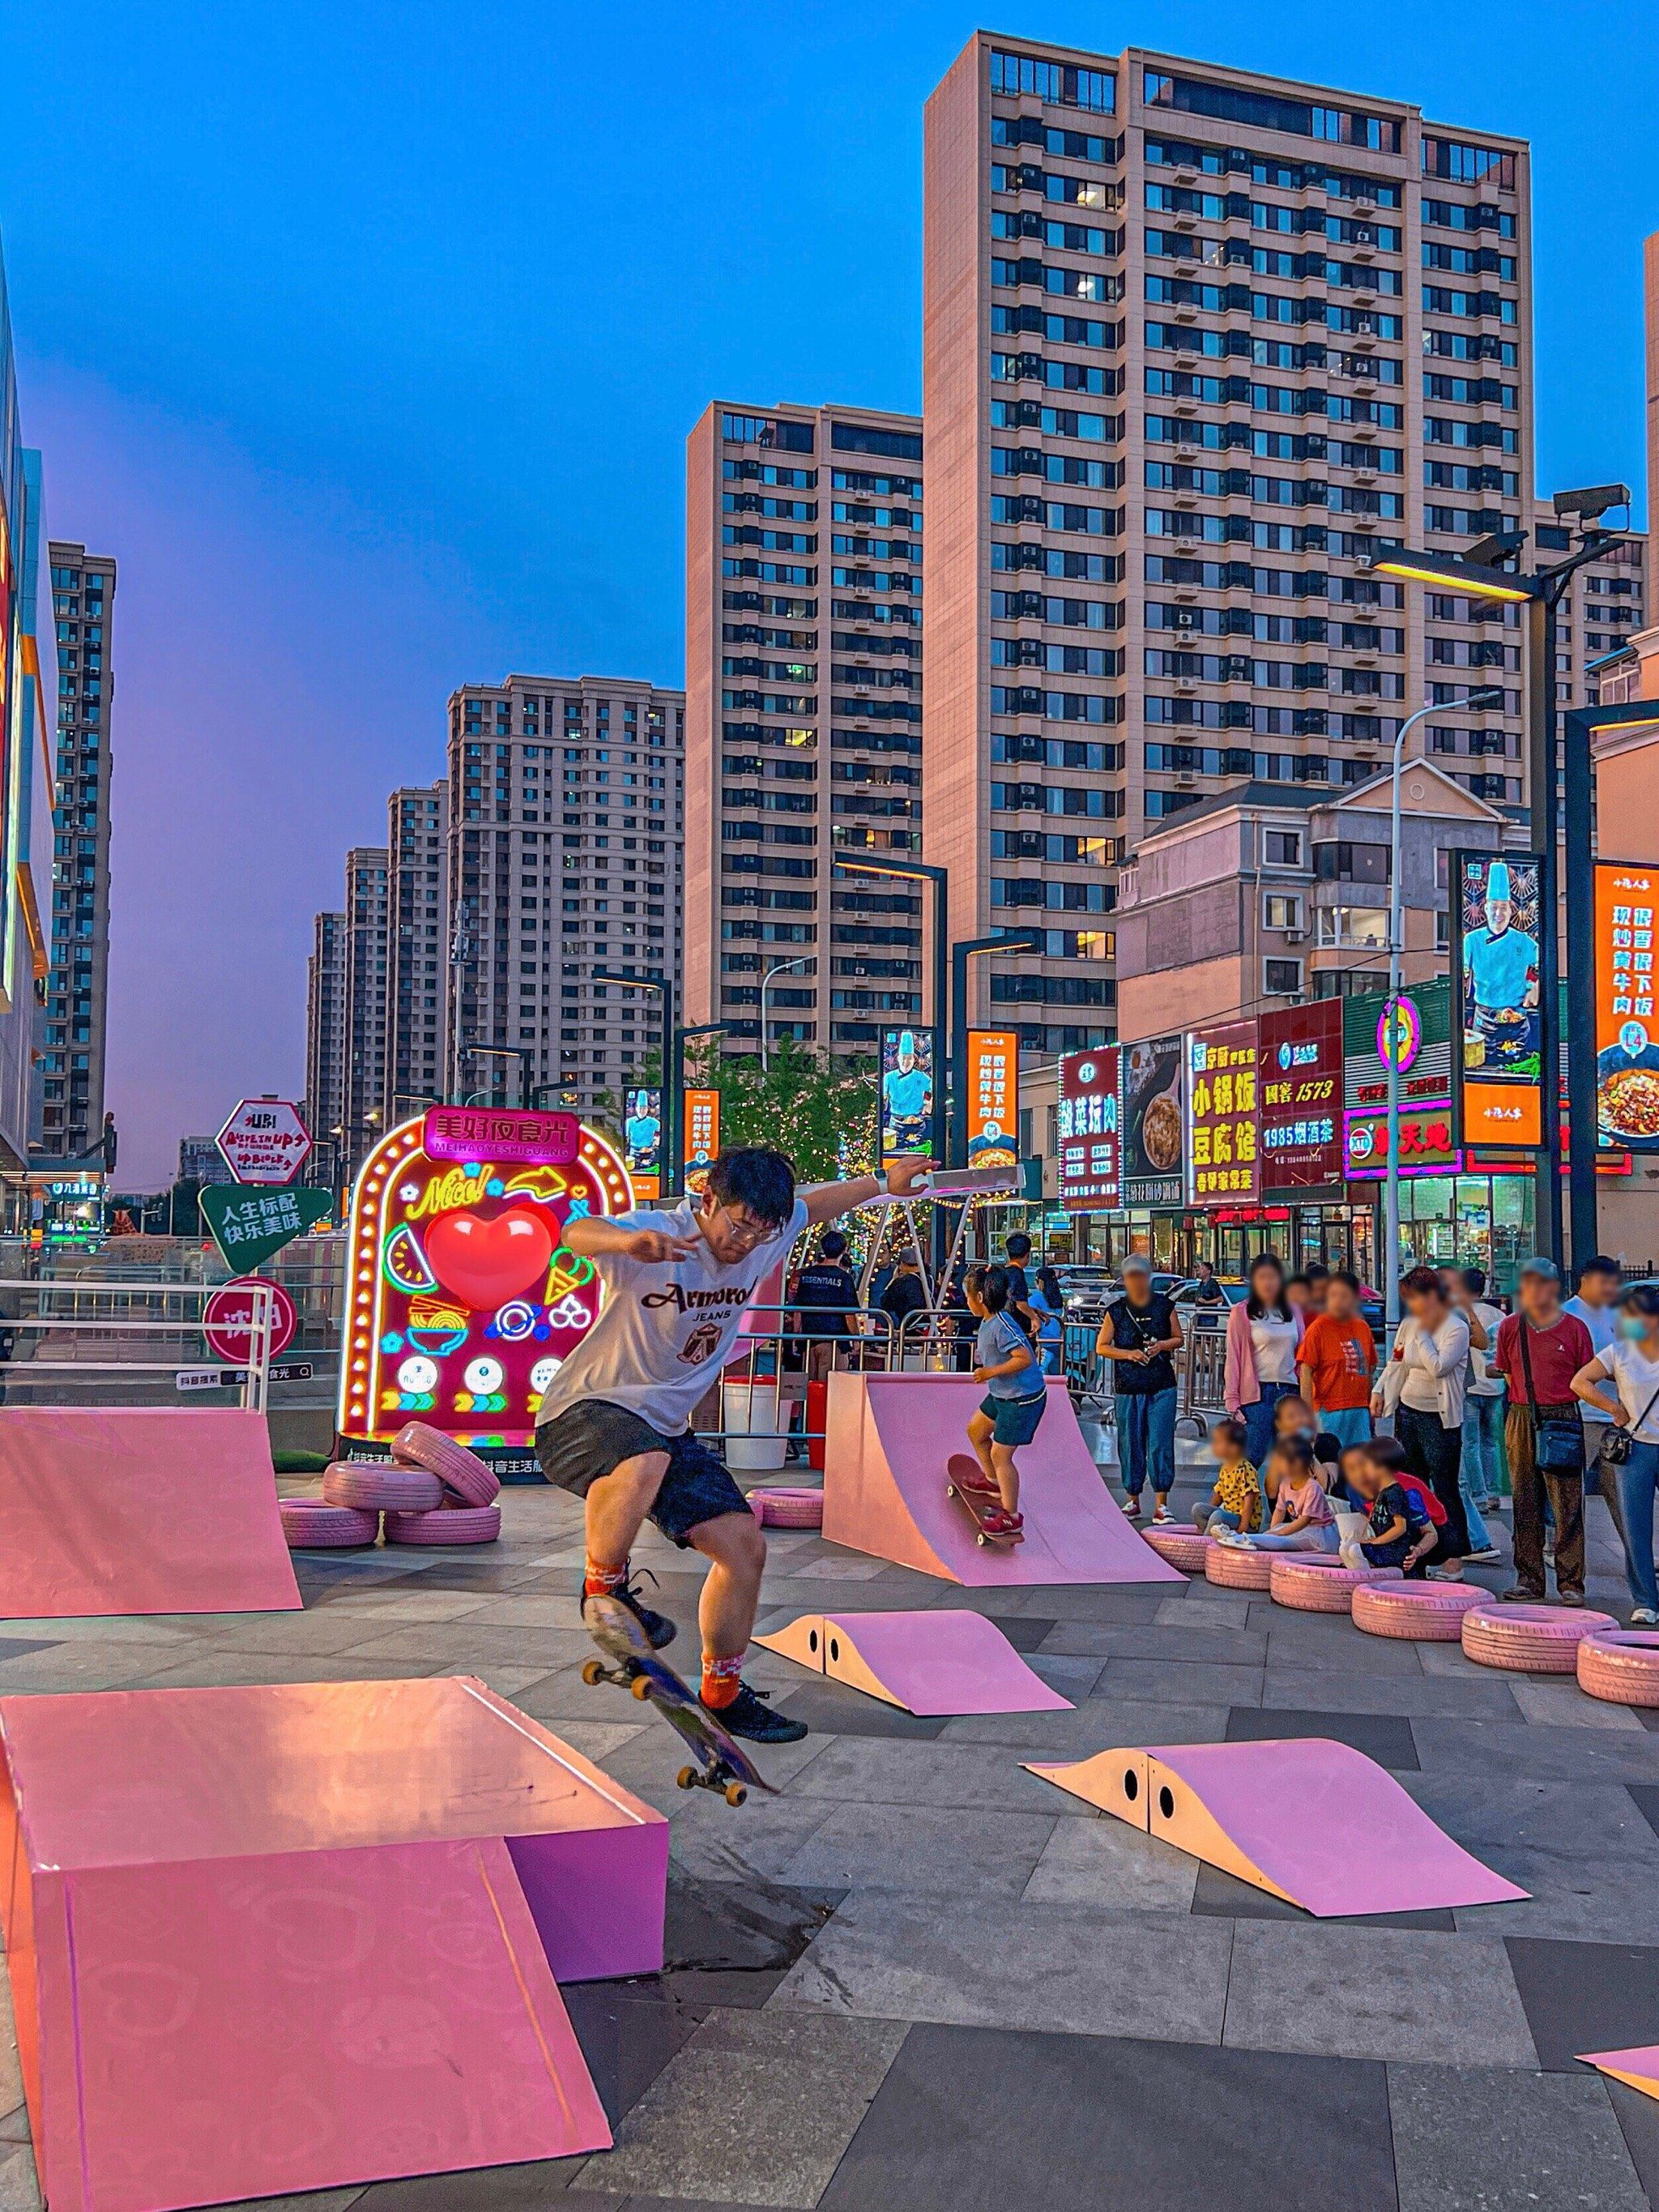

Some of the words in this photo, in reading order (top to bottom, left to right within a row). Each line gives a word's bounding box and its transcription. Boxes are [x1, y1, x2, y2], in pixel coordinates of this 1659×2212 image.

[1193, 1071, 1256, 1117] 小锅饭
[1295, 1080, 1334, 1102] 1573
[436, 1115, 569, 1144] 美好夜食光
[1193, 1121, 1256, 1165] 豆腐馆
[1264, 1118, 1333, 1148] 1985烟酒茶
[435, 1142, 569, 1158] MEIHAOYESHIGUANG
[221, 1193, 298, 1225] 人生标配
[224, 1212, 302, 1245] 快乐美味
[693, 1310, 731, 1322] JEANS
[180, 1374, 219, 1386] 抖音搜索
[235, 1367, 290, 1382] 美食光
